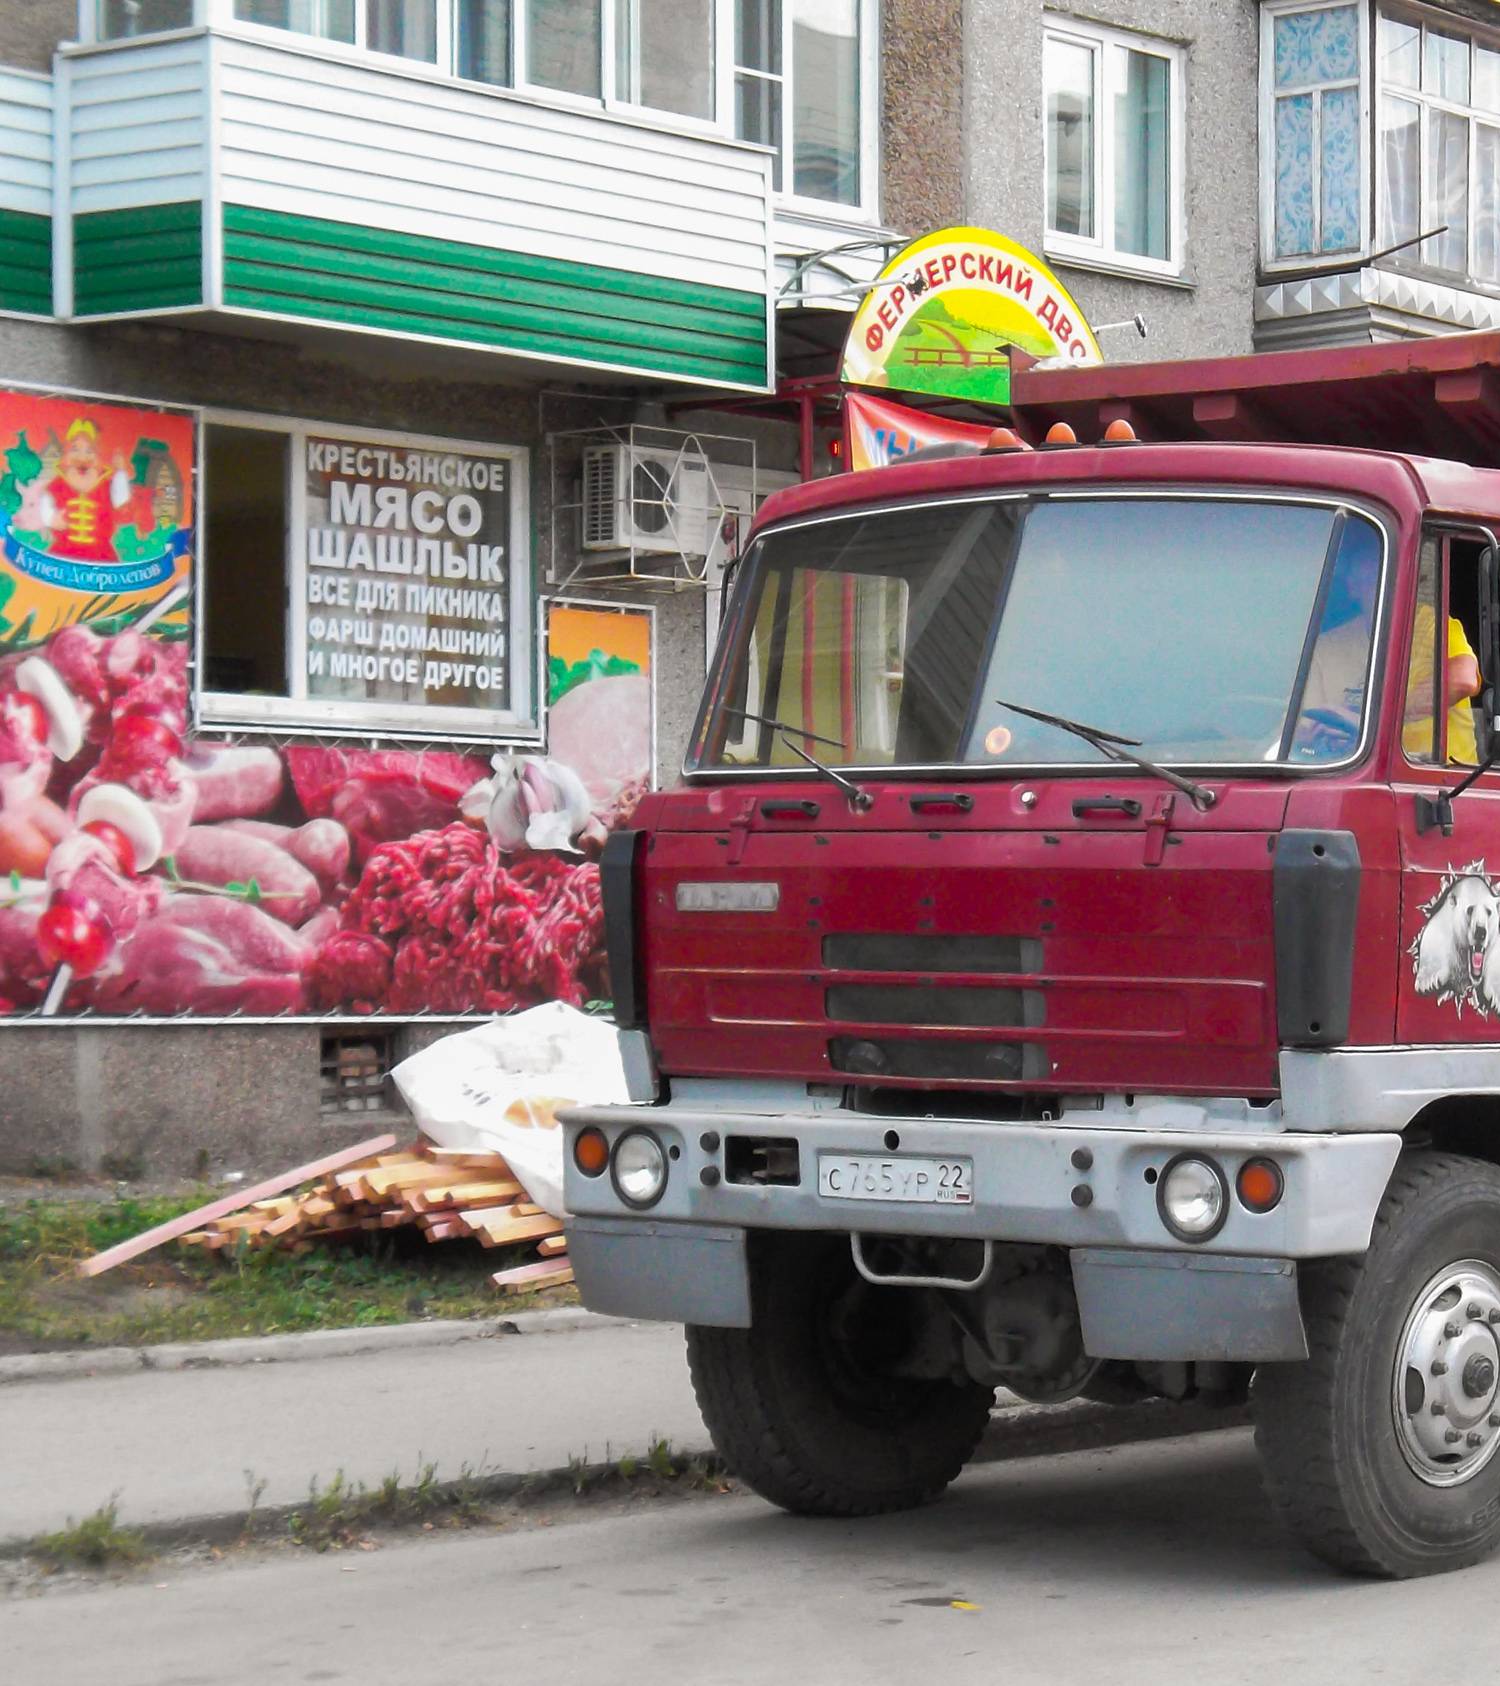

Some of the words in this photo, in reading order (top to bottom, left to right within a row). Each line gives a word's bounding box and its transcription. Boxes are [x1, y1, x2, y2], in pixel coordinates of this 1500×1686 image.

[308, 442, 504, 491] КРЕСТЬЯНСКОЕ
[330, 481, 483, 537] МЯСО
[308, 528, 504, 582] ШАШЛЫК
[308, 574, 350, 606] ВСЕ
[355, 579, 399, 613] ДЛЯ
[405, 584, 504, 622] ПИКНИКА
[309, 617, 373, 645] ФАРШ
[379, 622, 504, 658] ДОМАШНИЙ
[309, 651, 324, 676] И
[330, 653, 419, 684] МНОГОЕ
[424, 660, 504, 690] ДРУГОЕ
[938, 1164, 963, 1188] 22
